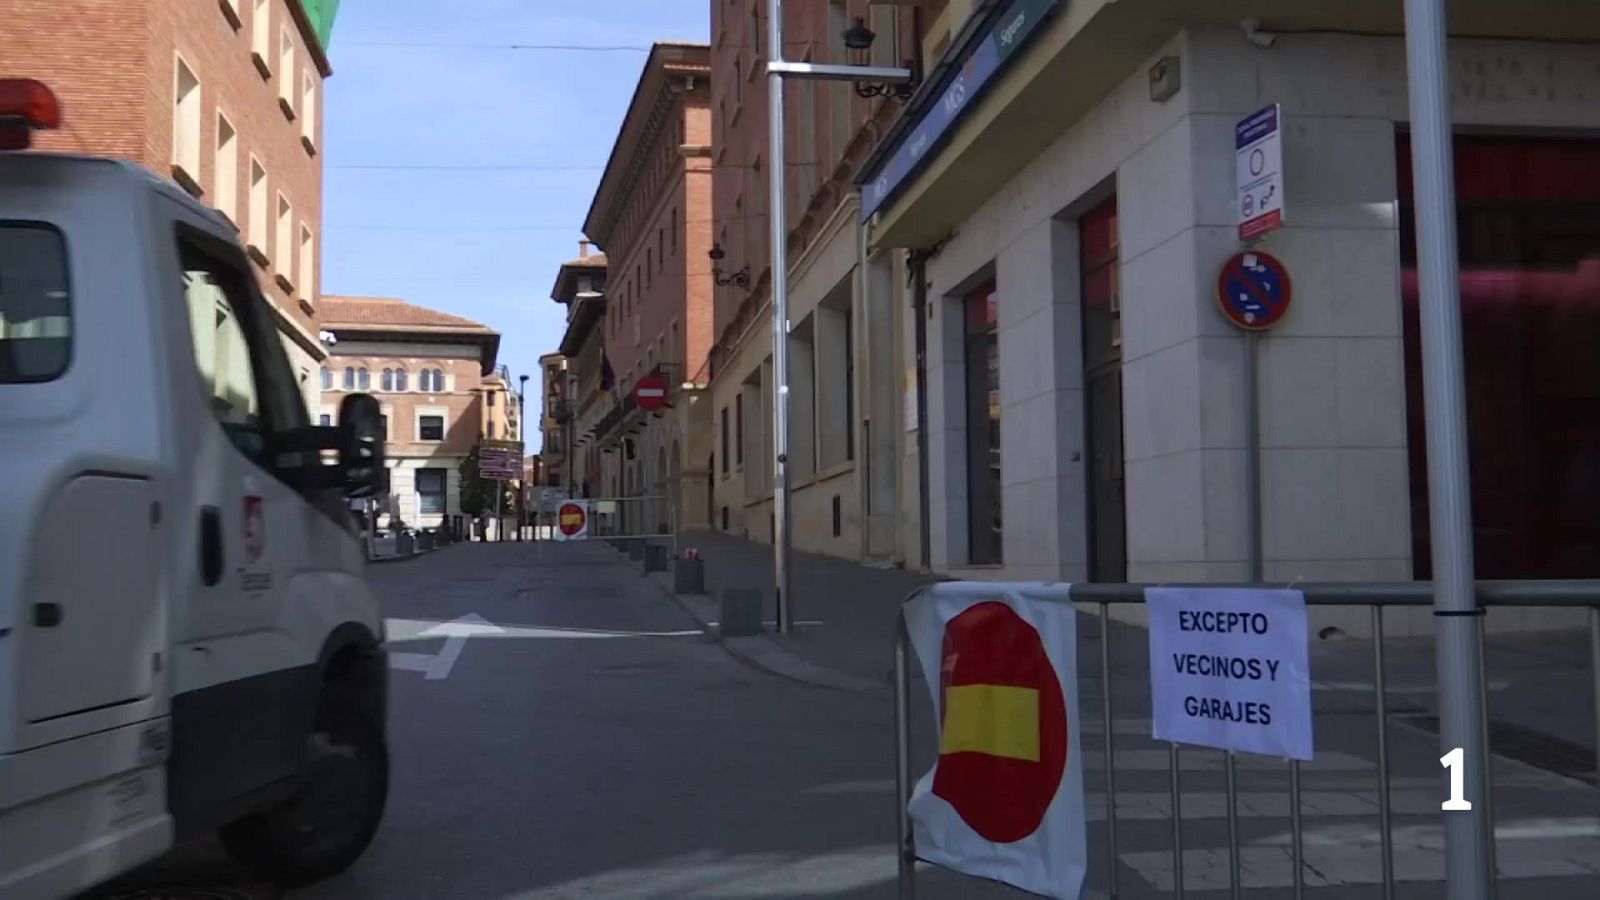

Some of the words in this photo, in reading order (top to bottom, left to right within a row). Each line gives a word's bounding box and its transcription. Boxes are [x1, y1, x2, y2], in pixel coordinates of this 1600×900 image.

[1178, 610, 1268, 635] EXCEPTO
[1173, 653, 1262, 680] VECINOS
[1265, 659, 1280, 682] Y
[1184, 696, 1271, 725] GARAJES
